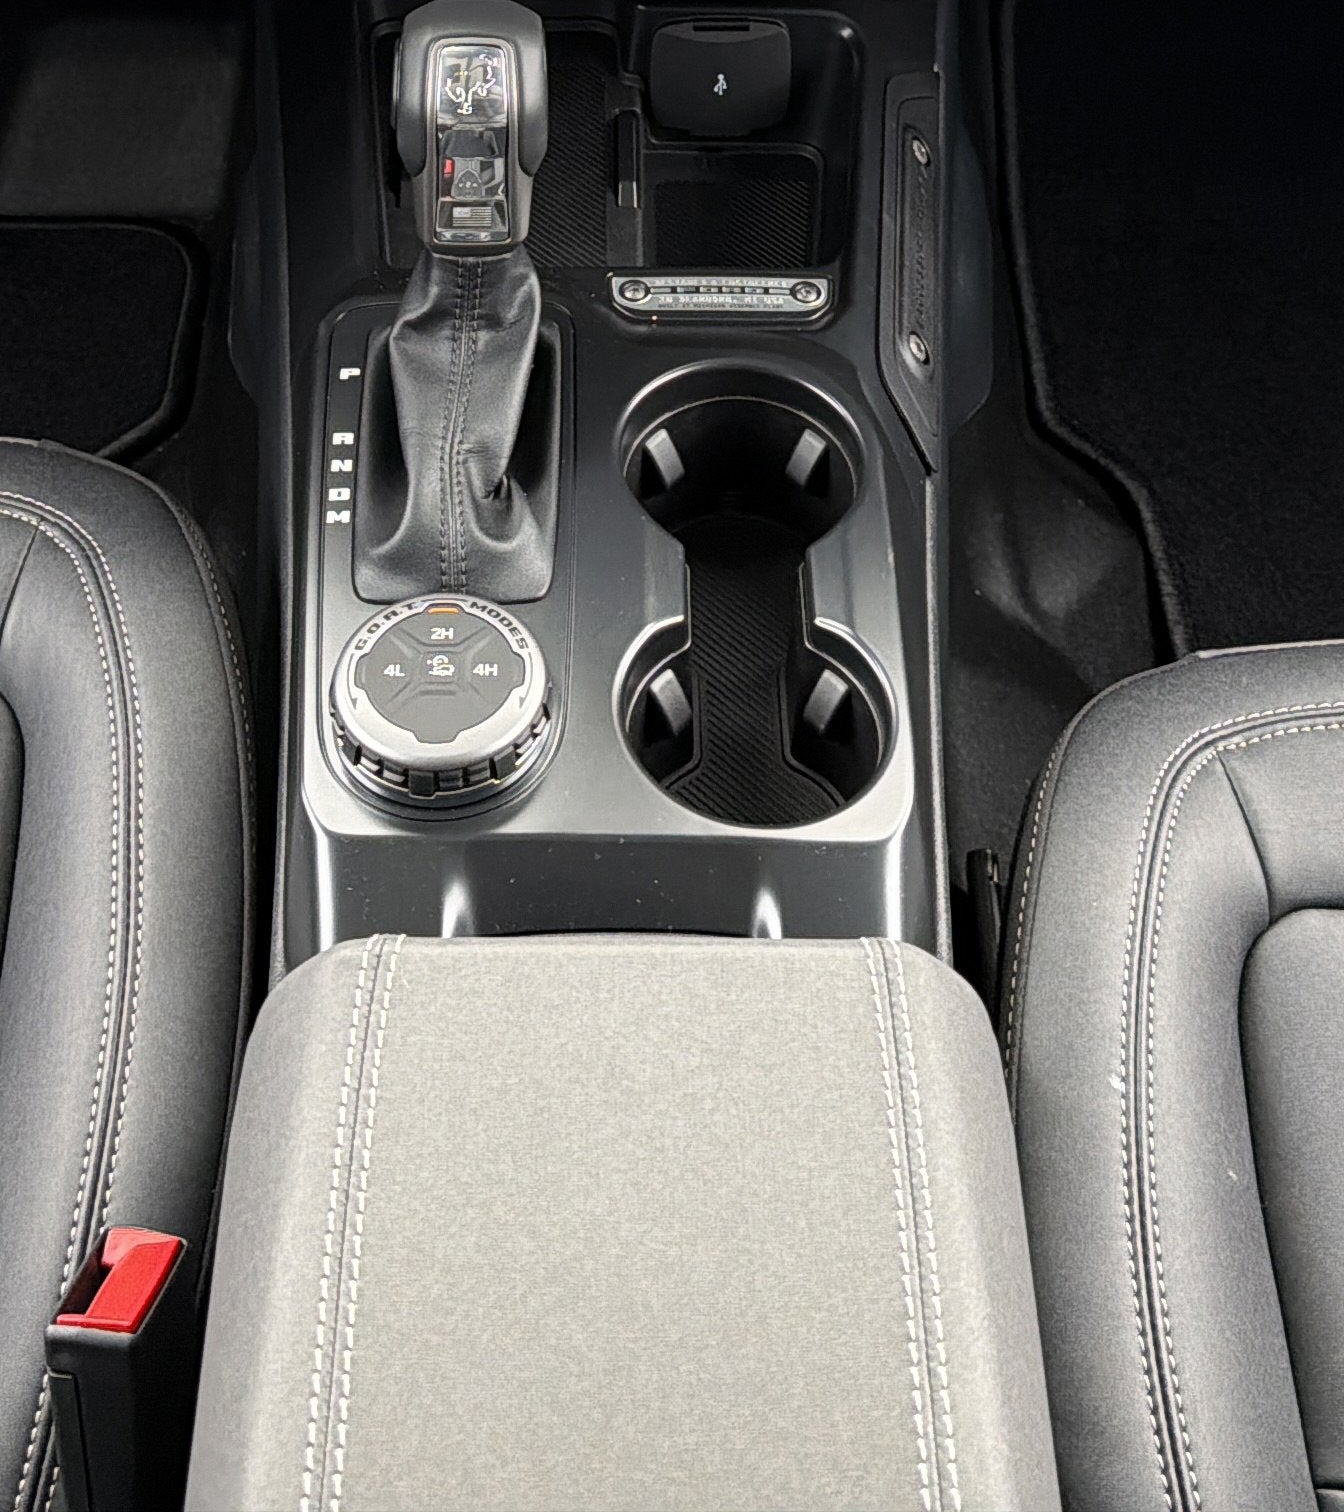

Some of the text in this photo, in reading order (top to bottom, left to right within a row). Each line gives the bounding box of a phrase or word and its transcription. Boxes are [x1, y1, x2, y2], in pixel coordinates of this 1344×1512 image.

[339, 367, 361, 380] P
[330, 459, 353, 472] N
[328, 487, 351, 501] D
[326, 510, 351, 524] M
[469, 601, 529, 650] MODES
[430, 627, 454, 640] 2H
[383, 664, 406, 677] 4L
[473, 663, 498, 677] 4H
